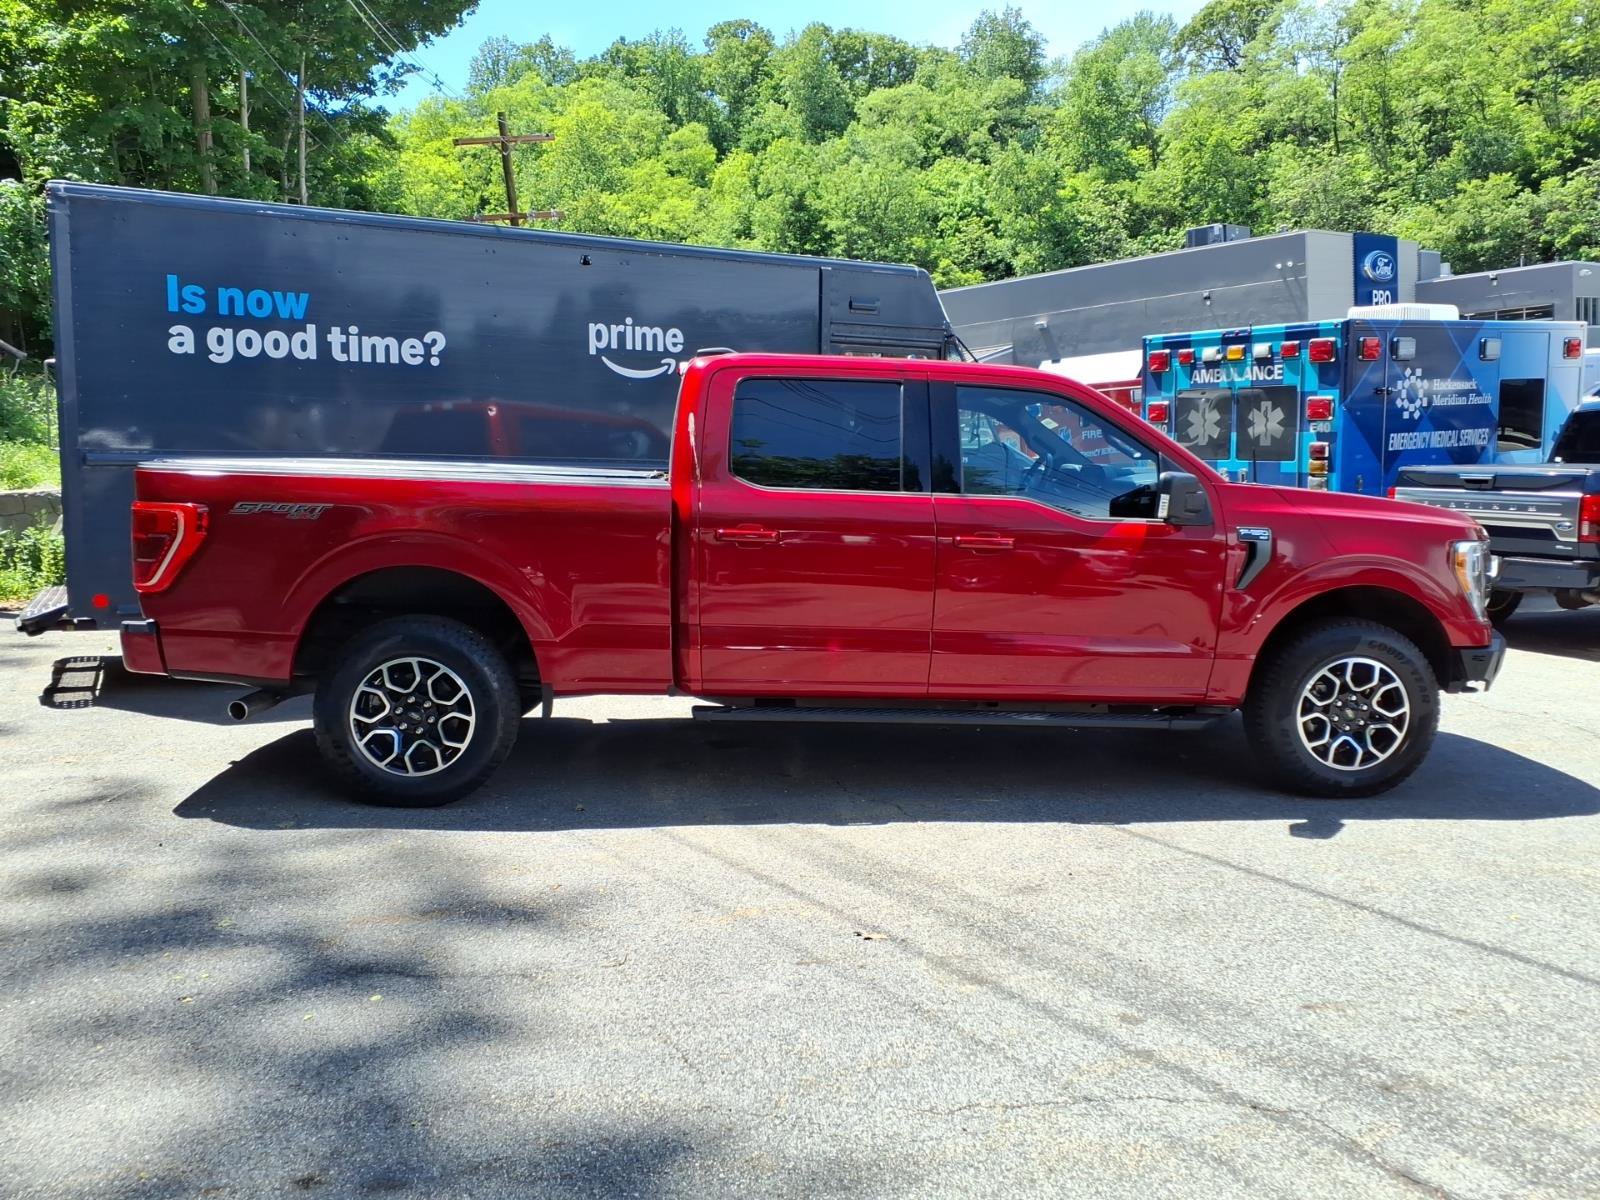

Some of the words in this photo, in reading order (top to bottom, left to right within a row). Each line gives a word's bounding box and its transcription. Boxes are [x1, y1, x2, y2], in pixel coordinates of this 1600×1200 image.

[167, 274, 206, 314] Is
[217, 287, 309, 320] now
[1372, 289, 1392, 306] PRO
[588, 316, 685, 355] prime
[167, 324, 195, 354] a
[206, 324, 317, 363] good
[327, 325, 446, 366] time?
[1190, 364, 1284, 384] AMBULANCE
[1432, 378, 1477, 391] Hackensack
[1432, 394, 1466, 406] Meridian
[1467, 393, 1492, 404] Health
[1081, 429, 1103, 440] FIRE
[1309, 422, 1331, 433] E40
[1388, 432, 1431, 451] EMERGENCY
[1430, 430, 1459, 448] MEDICAL
[1459, 428, 1490, 447] SERVICES
[229, 502, 334, 515] SPORT
